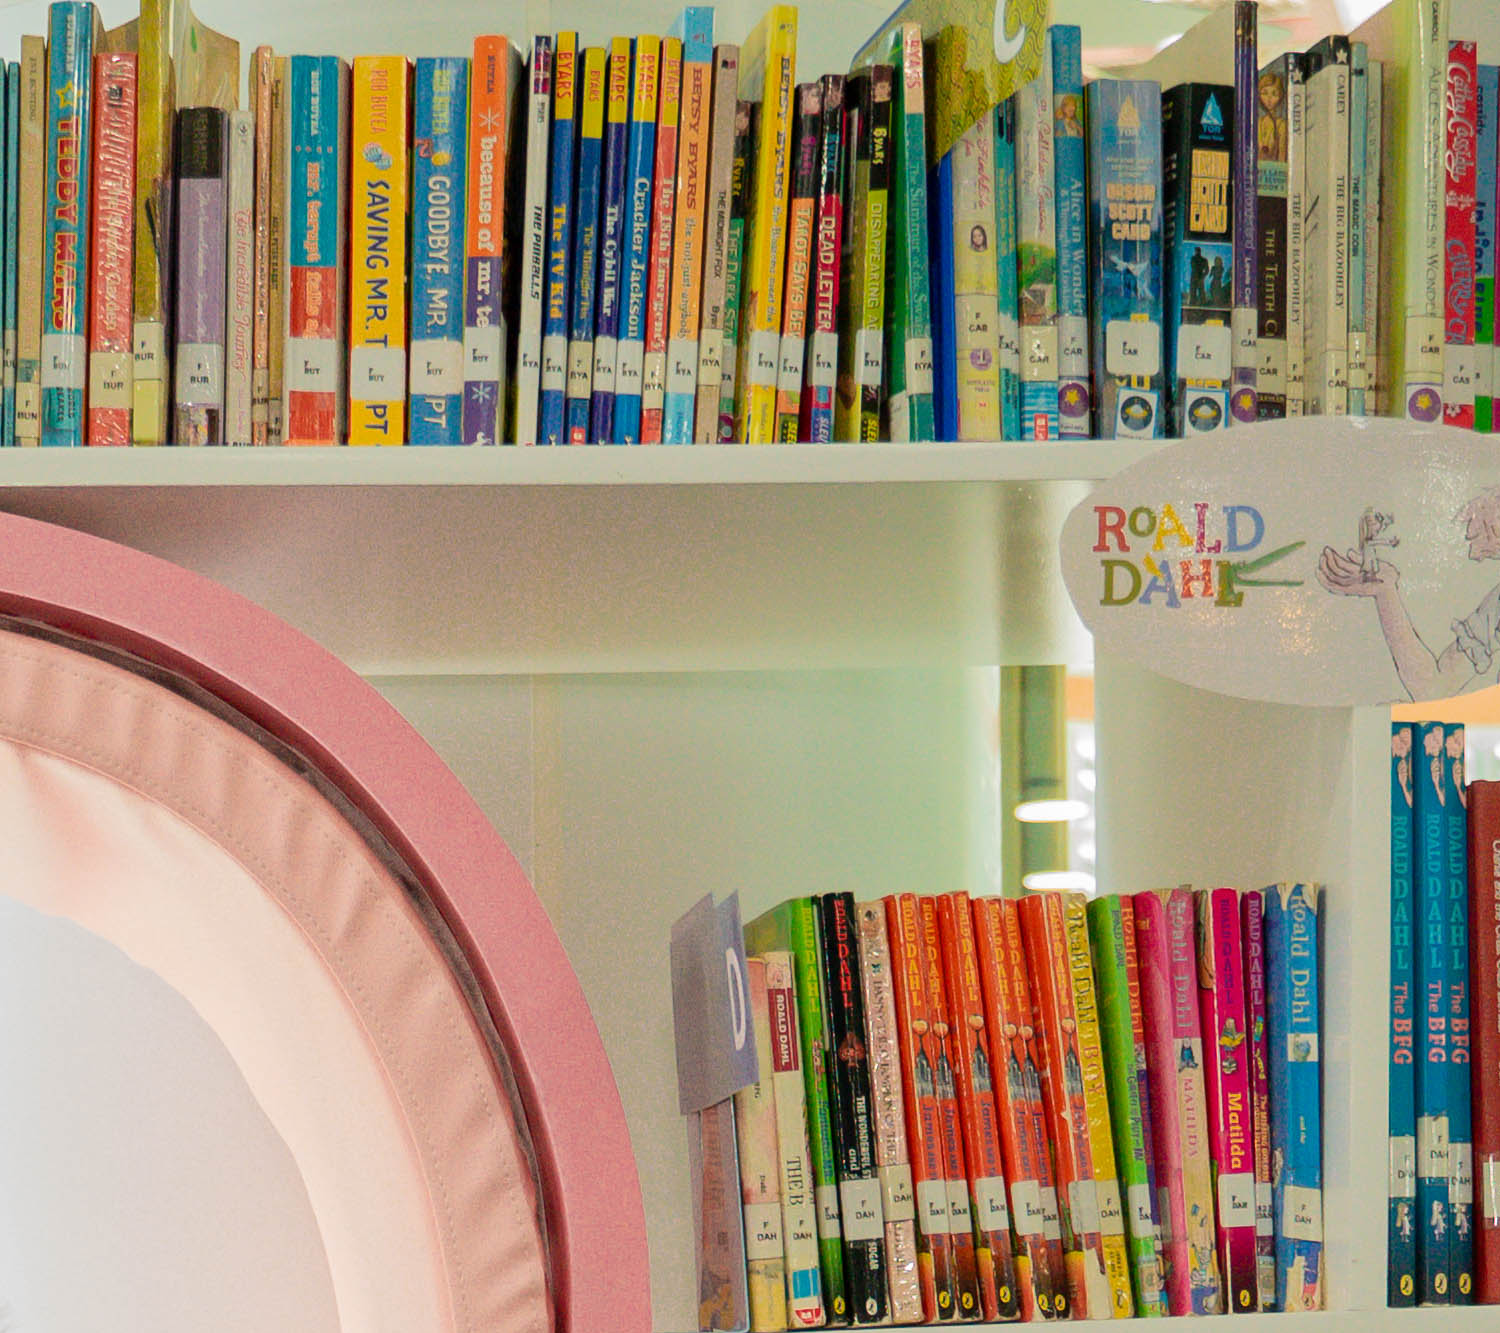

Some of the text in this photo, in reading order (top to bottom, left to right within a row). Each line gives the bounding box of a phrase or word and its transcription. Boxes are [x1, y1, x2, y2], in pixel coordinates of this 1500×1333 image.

[556, 52, 572, 99] BYARS
[52, 117, 81, 331] TEDDY MARS
[478, 134, 497, 250] because of
[365, 180, 390, 331] SAVING MR.
[424, 175, 452, 331] GOODBYE, MR.
[549, 203, 567, 320] The TV Kid
[628, 177, 650, 338] Cracker Jackson
[1092, 502, 1265, 555] ROALD
[1100, 555, 1245, 608] DAHL
[726, 949, 747, 1050] D
[1426, 982, 1445, 1065] The BFG
[1228, 1093, 1244, 1170] Matilda
